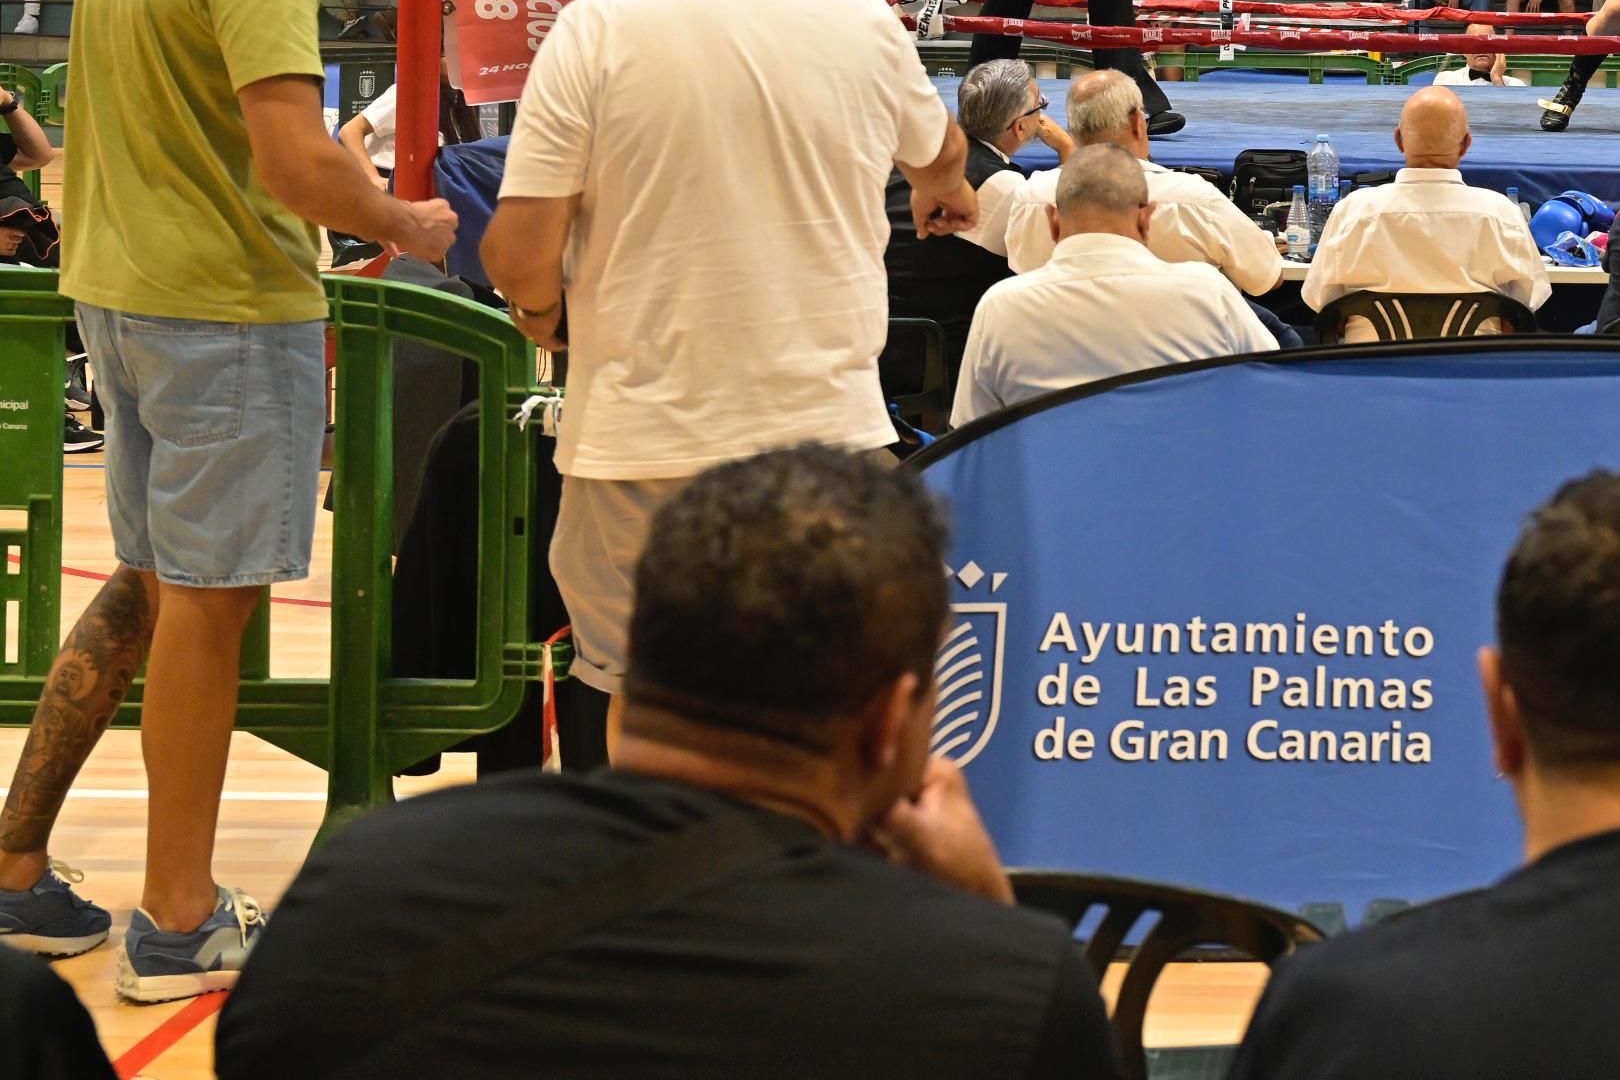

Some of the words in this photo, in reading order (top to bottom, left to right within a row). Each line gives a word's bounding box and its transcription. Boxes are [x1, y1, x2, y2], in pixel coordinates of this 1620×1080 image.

[479, 66, 500, 76] 24
[1038, 612, 1435, 663] Ayuntamiento
[1037, 663, 1100, 707] de
[1135, 666, 1218, 708] Las
[1251, 665, 1434, 710] Palmas
[1033, 716, 1096, 761] de
[1109, 719, 1229, 761] Gran
[1246, 720, 1432, 763] Canaria
